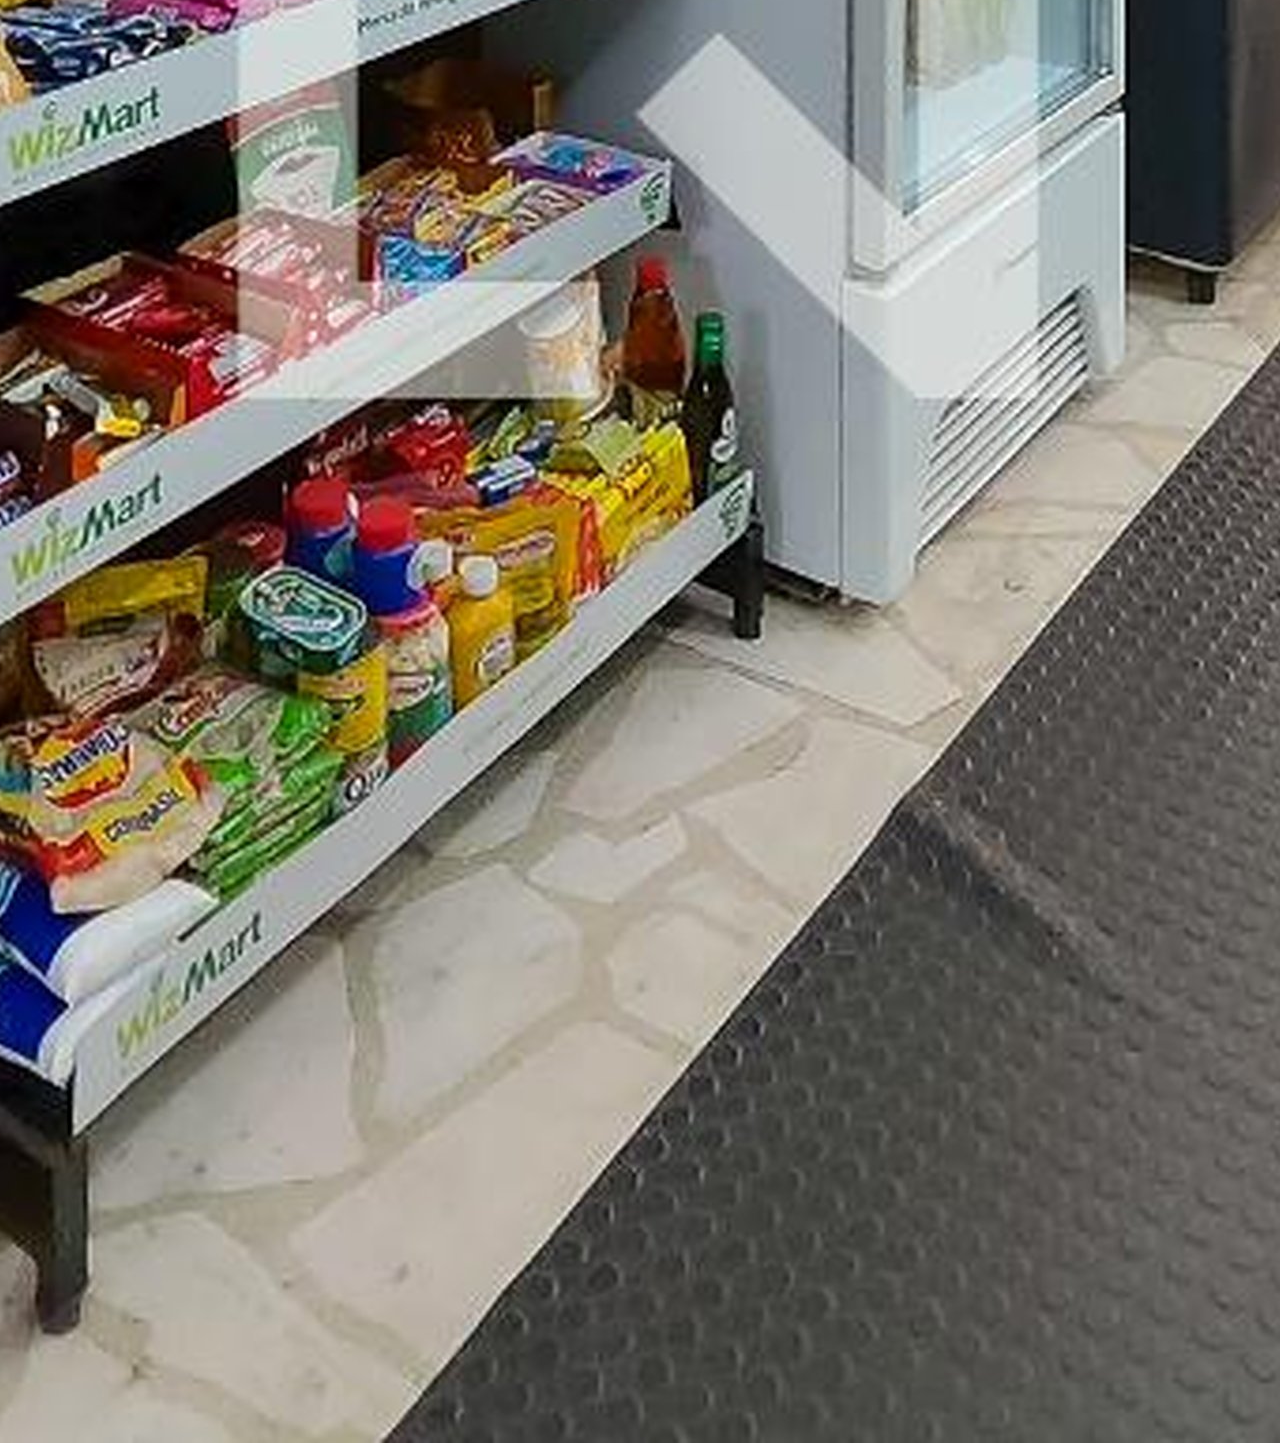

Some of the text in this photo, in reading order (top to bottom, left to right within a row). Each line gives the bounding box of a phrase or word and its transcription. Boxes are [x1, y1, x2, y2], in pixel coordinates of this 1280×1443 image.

[8, 87, 161, 172] WizMart
[10, 471, 165, 589] WizMart
[115, 910, 264, 1057] WizMart
